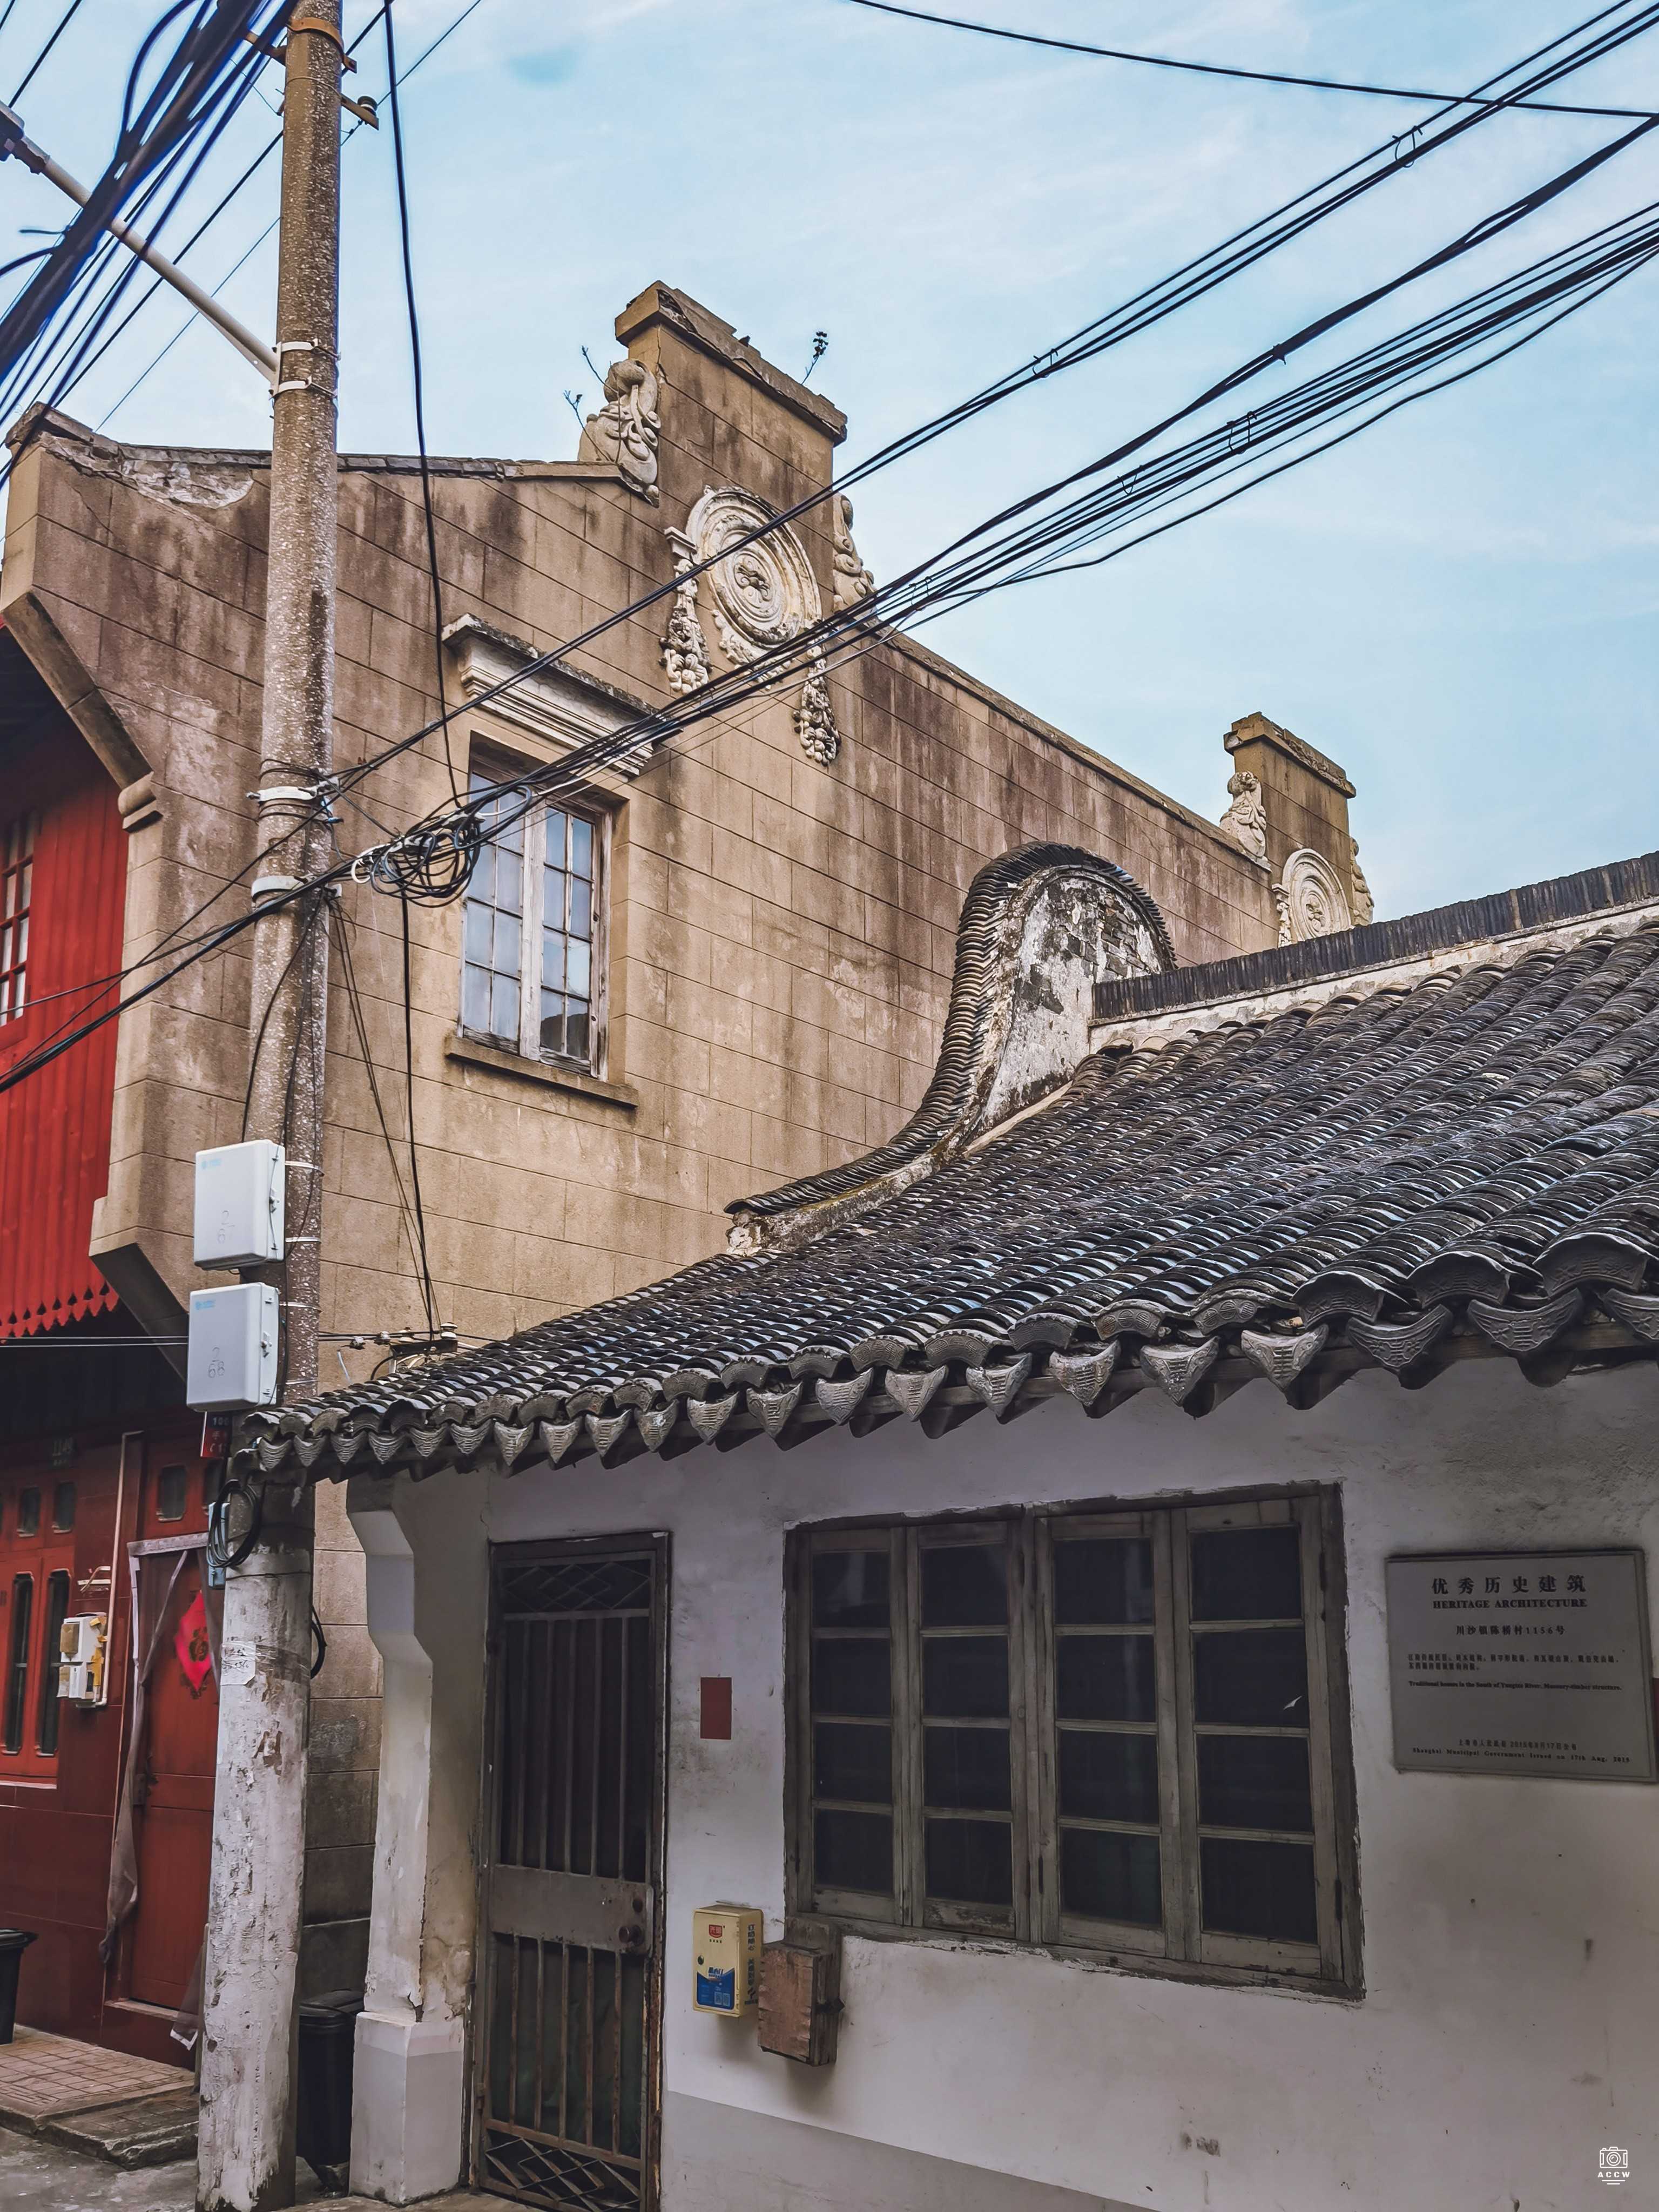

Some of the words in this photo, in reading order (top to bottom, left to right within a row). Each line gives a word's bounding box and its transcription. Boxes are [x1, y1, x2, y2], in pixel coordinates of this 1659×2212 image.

[1431, 1574, 1586, 1595] 优秀历史建筑
[1433, 1600, 1490, 1609] HERITAGE
[1494, 1599, 1588, 1608] ARCHITECTURE
